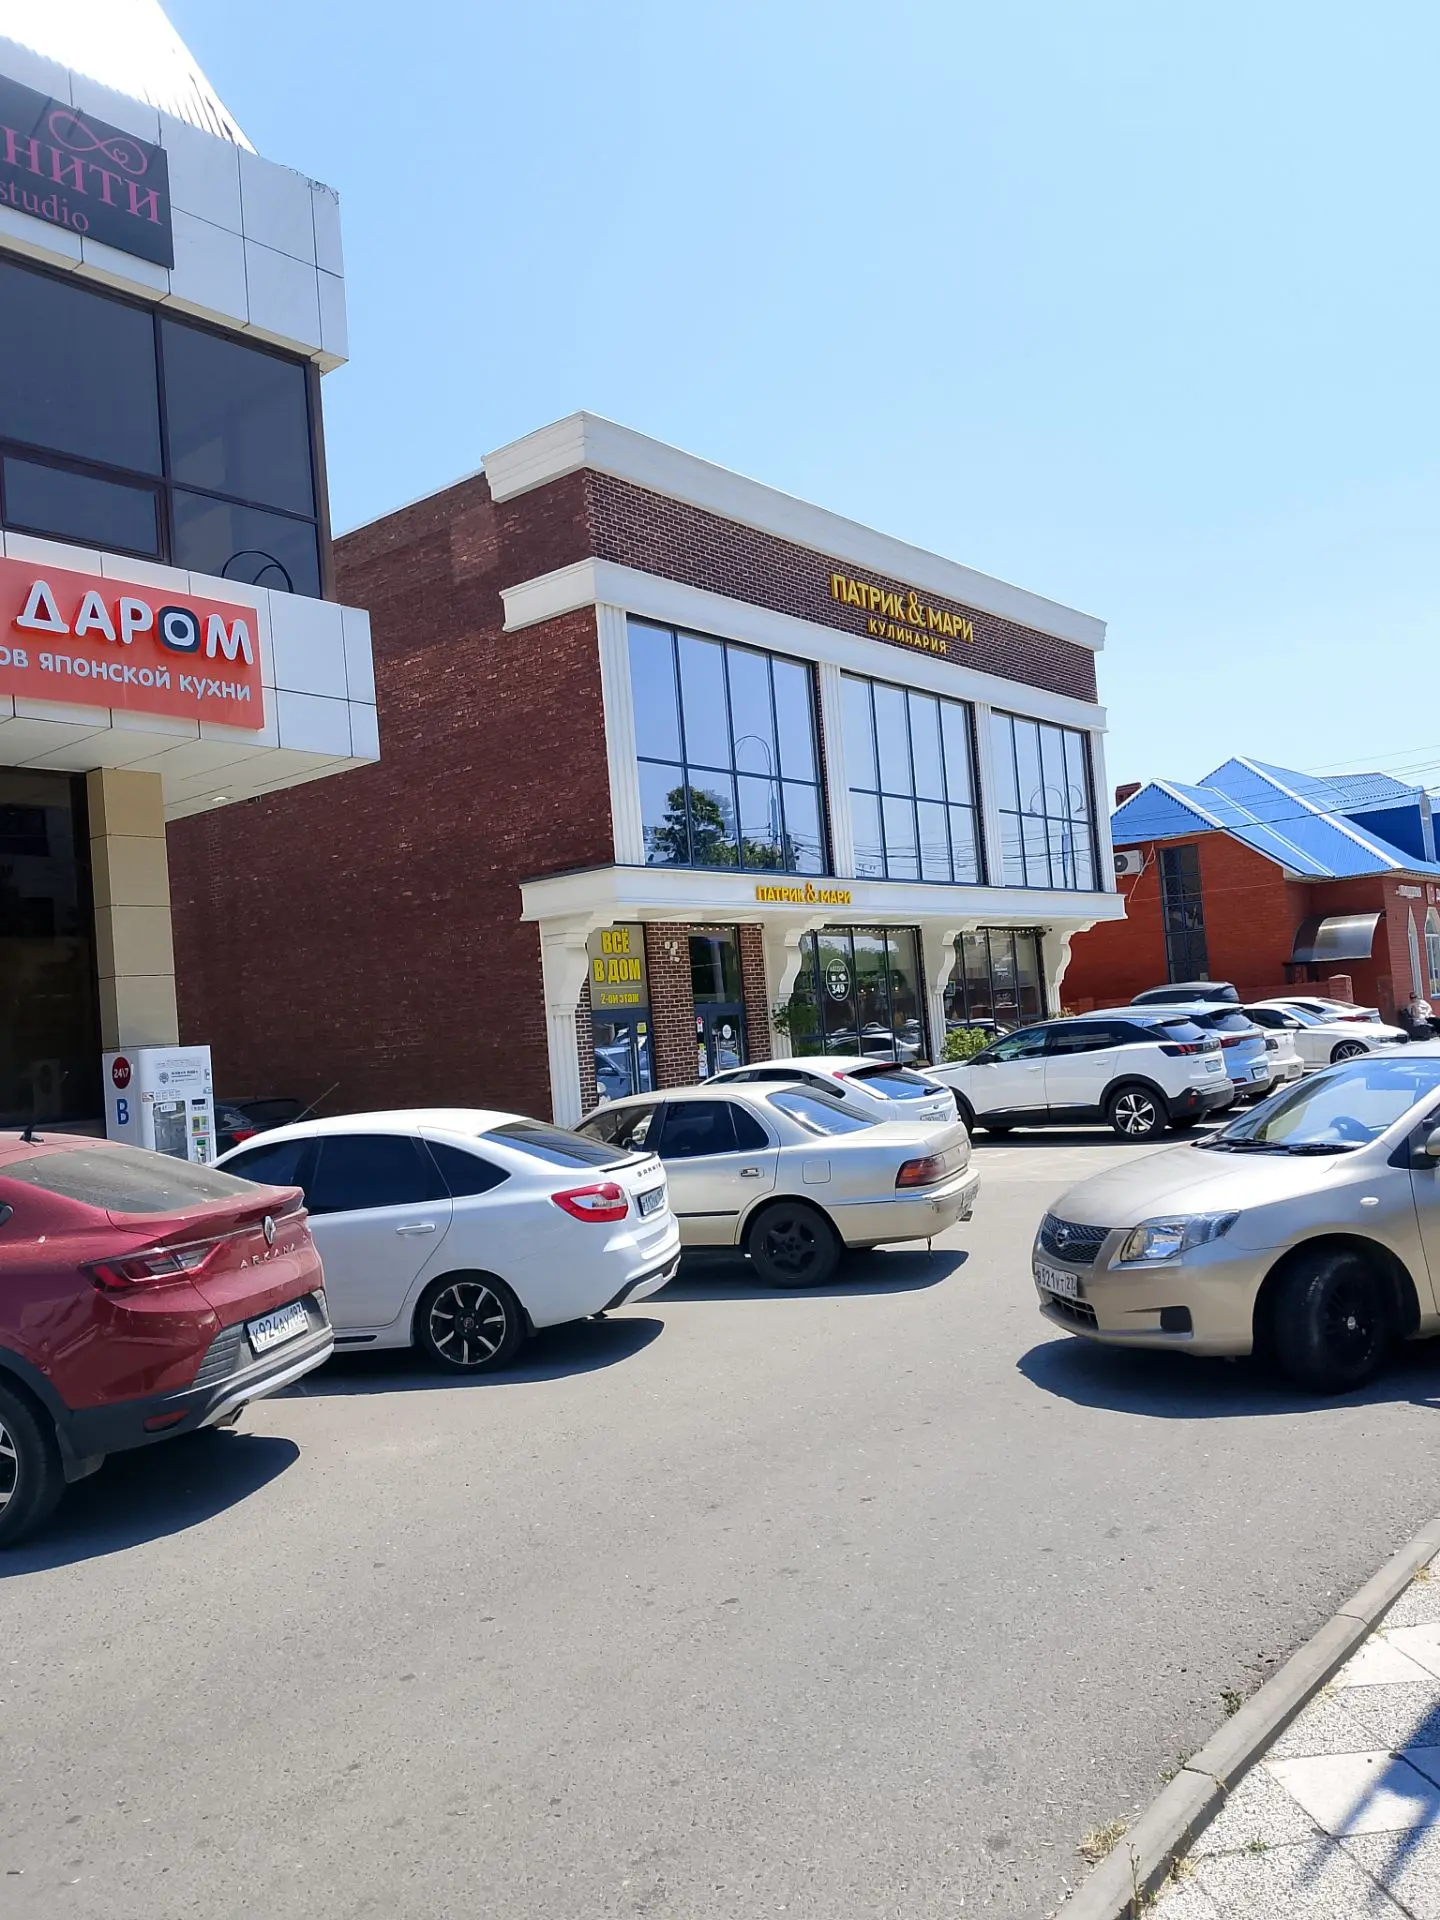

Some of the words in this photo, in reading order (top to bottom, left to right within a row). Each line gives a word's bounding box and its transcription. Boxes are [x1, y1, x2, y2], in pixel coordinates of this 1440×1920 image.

[0, 124, 163, 226] НИТИ
[0, 180, 90, 233] studio
[13, 579, 254, 666] ДАРОМ
[830, 573, 906, 620] ПАТРИК
[906, 591, 927, 628] &
[927, 606, 974, 643] МАРИ
[868, 615, 947, 654] КУЛИНАРИЯ
[756, 886, 803, 903] ПАТРИК
[805, 881, 817, 904] &
[818, 889, 852, 905] МАРИ
[601, 928, 630, 955] ВСЁ
[593, 959, 605, 982] В
[607, 958, 641, 985] ДОМ
[240, 1242, 296, 1270] ARKANA
